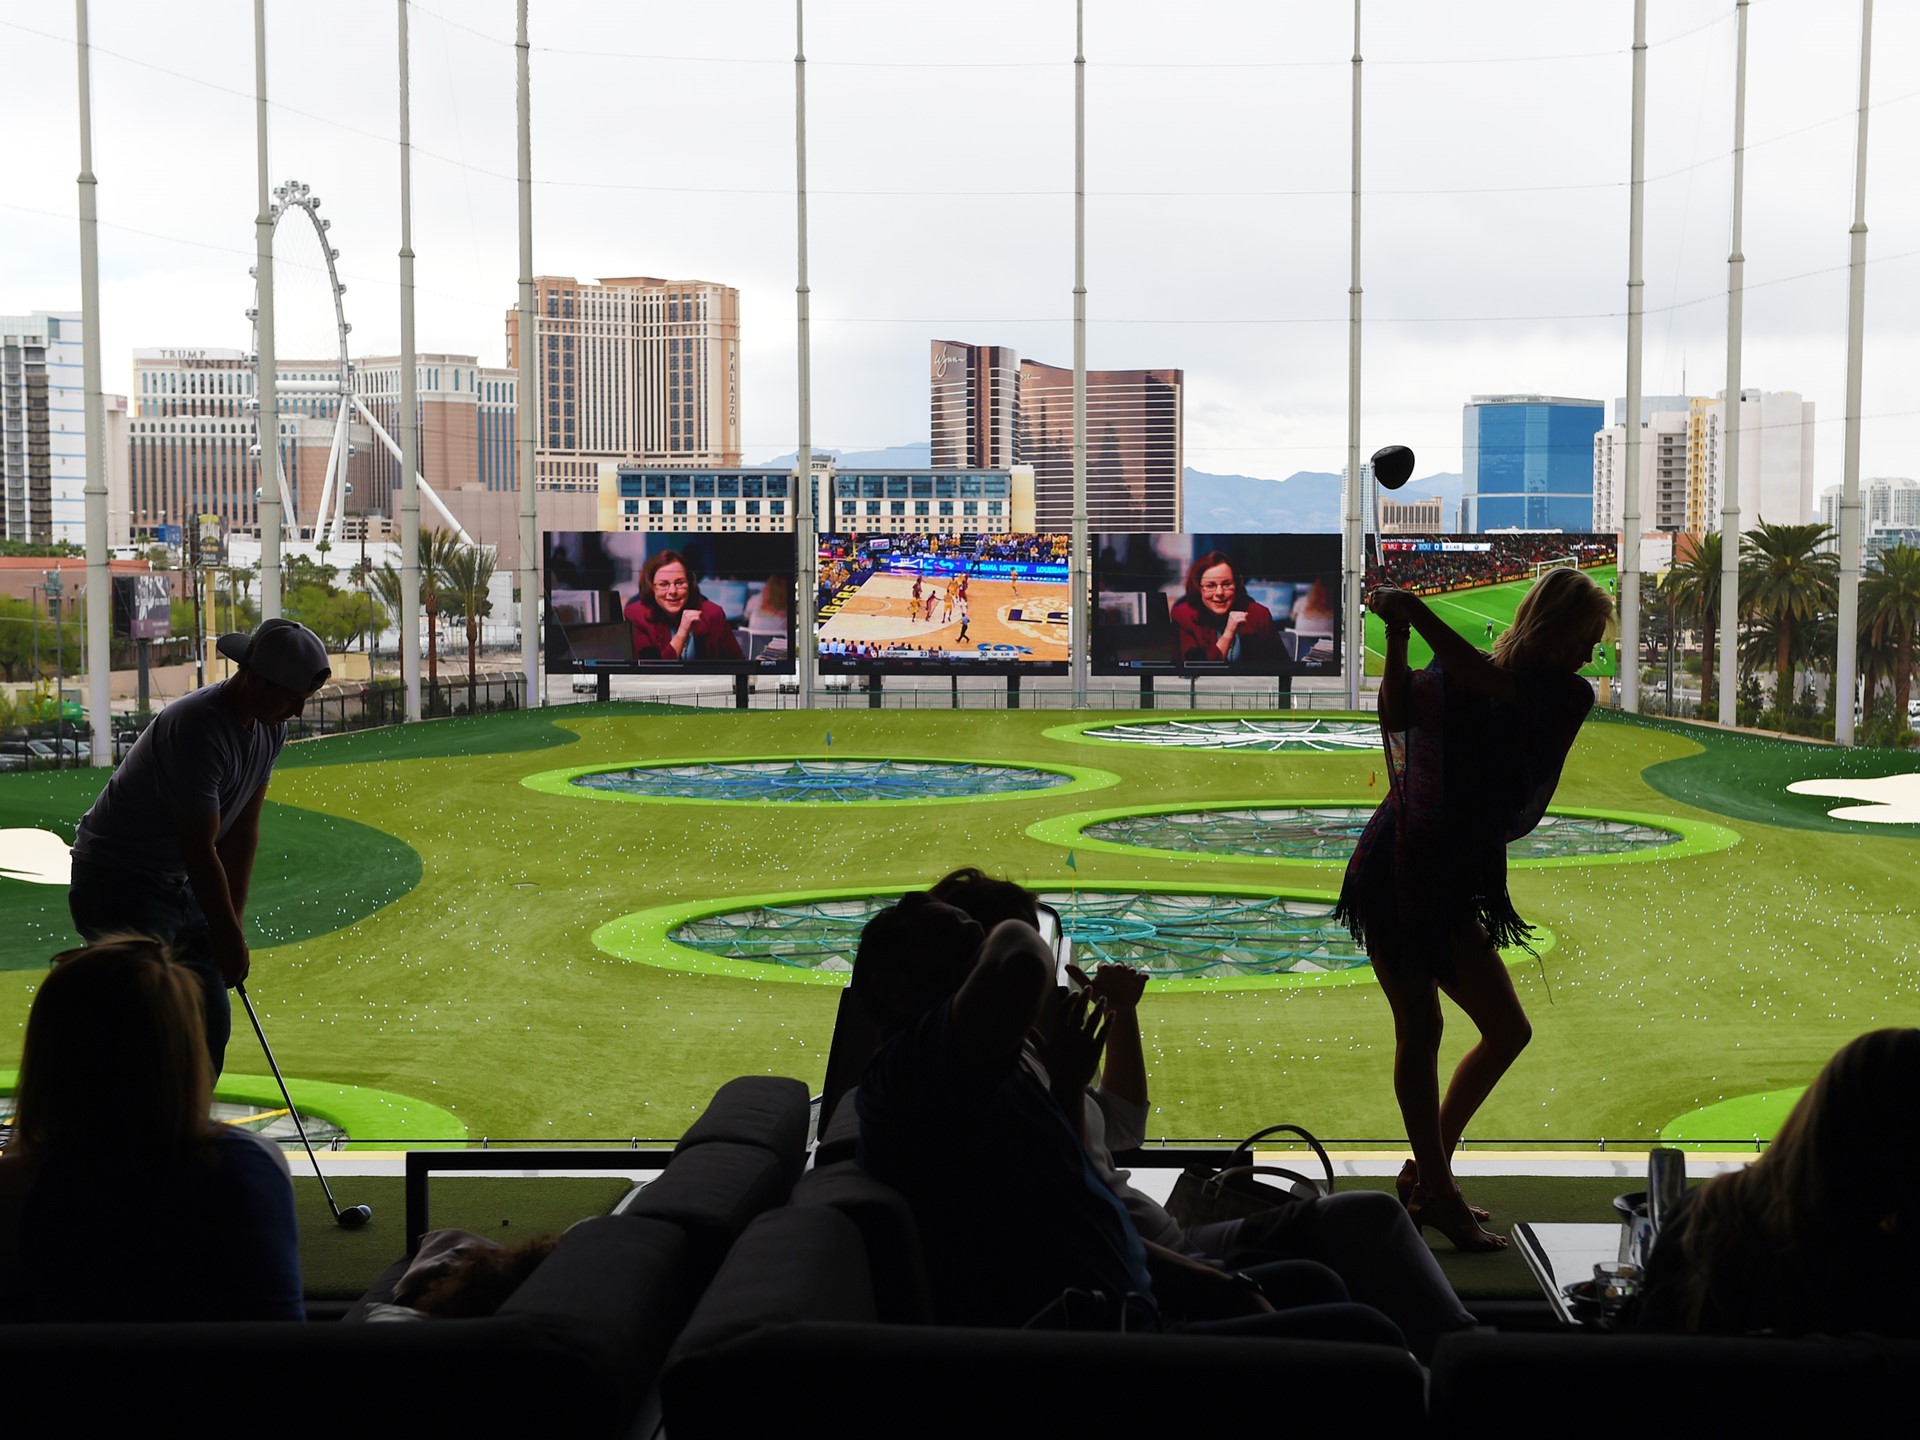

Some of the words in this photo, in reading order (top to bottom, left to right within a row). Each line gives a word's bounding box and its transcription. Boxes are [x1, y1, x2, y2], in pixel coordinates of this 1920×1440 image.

[160, 350, 206, 359] TRUMP
[184, 360, 248, 370] VENETI
[1401, 543, 1407, 551] 2
[1434, 543, 1440, 551] 0
